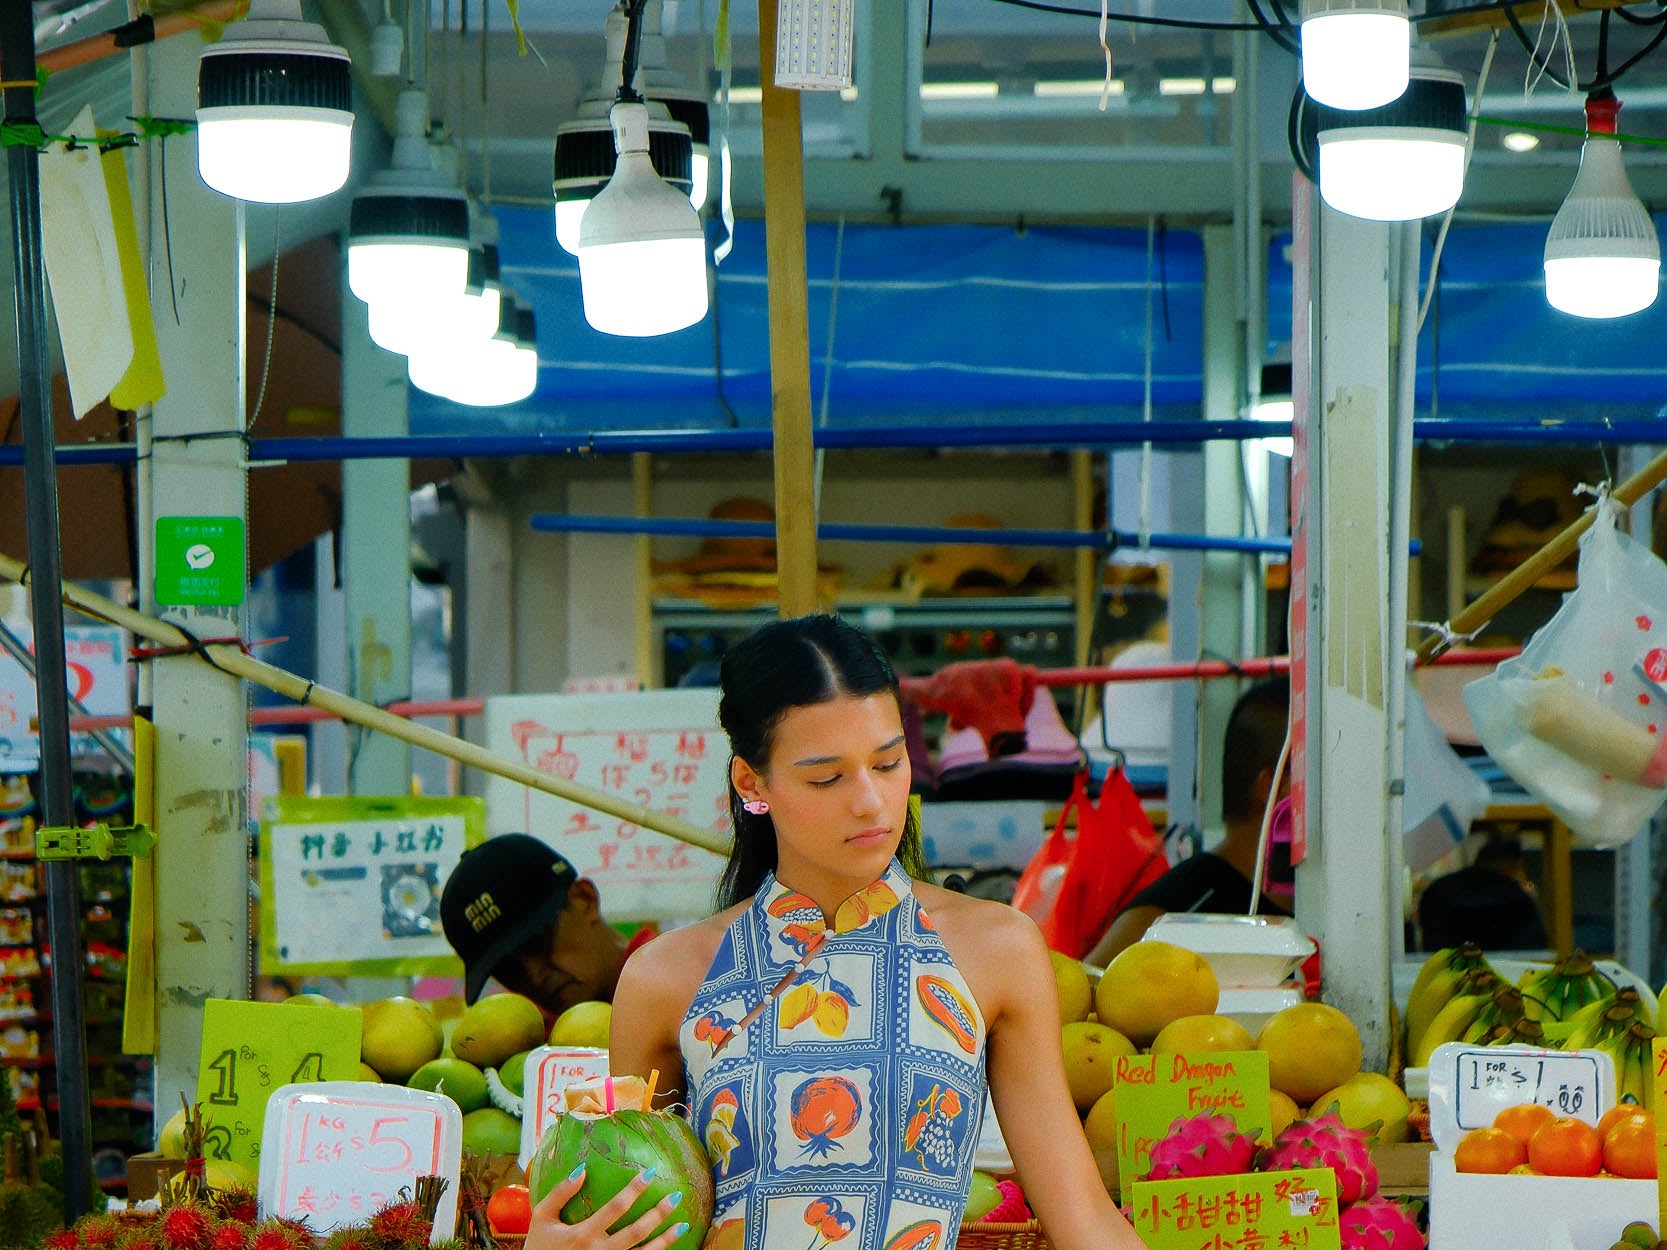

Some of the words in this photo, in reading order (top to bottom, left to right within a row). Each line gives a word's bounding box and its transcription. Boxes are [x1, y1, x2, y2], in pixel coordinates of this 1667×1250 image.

[208, 1049, 239, 1106] 1
[561, 1066, 584, 1077] FOR
[1116, 1055, 1157, 1085] Red
[1486, 1062, 1507, 1072] FOR
[1188, 1086, 1246, 1111] Fruit
